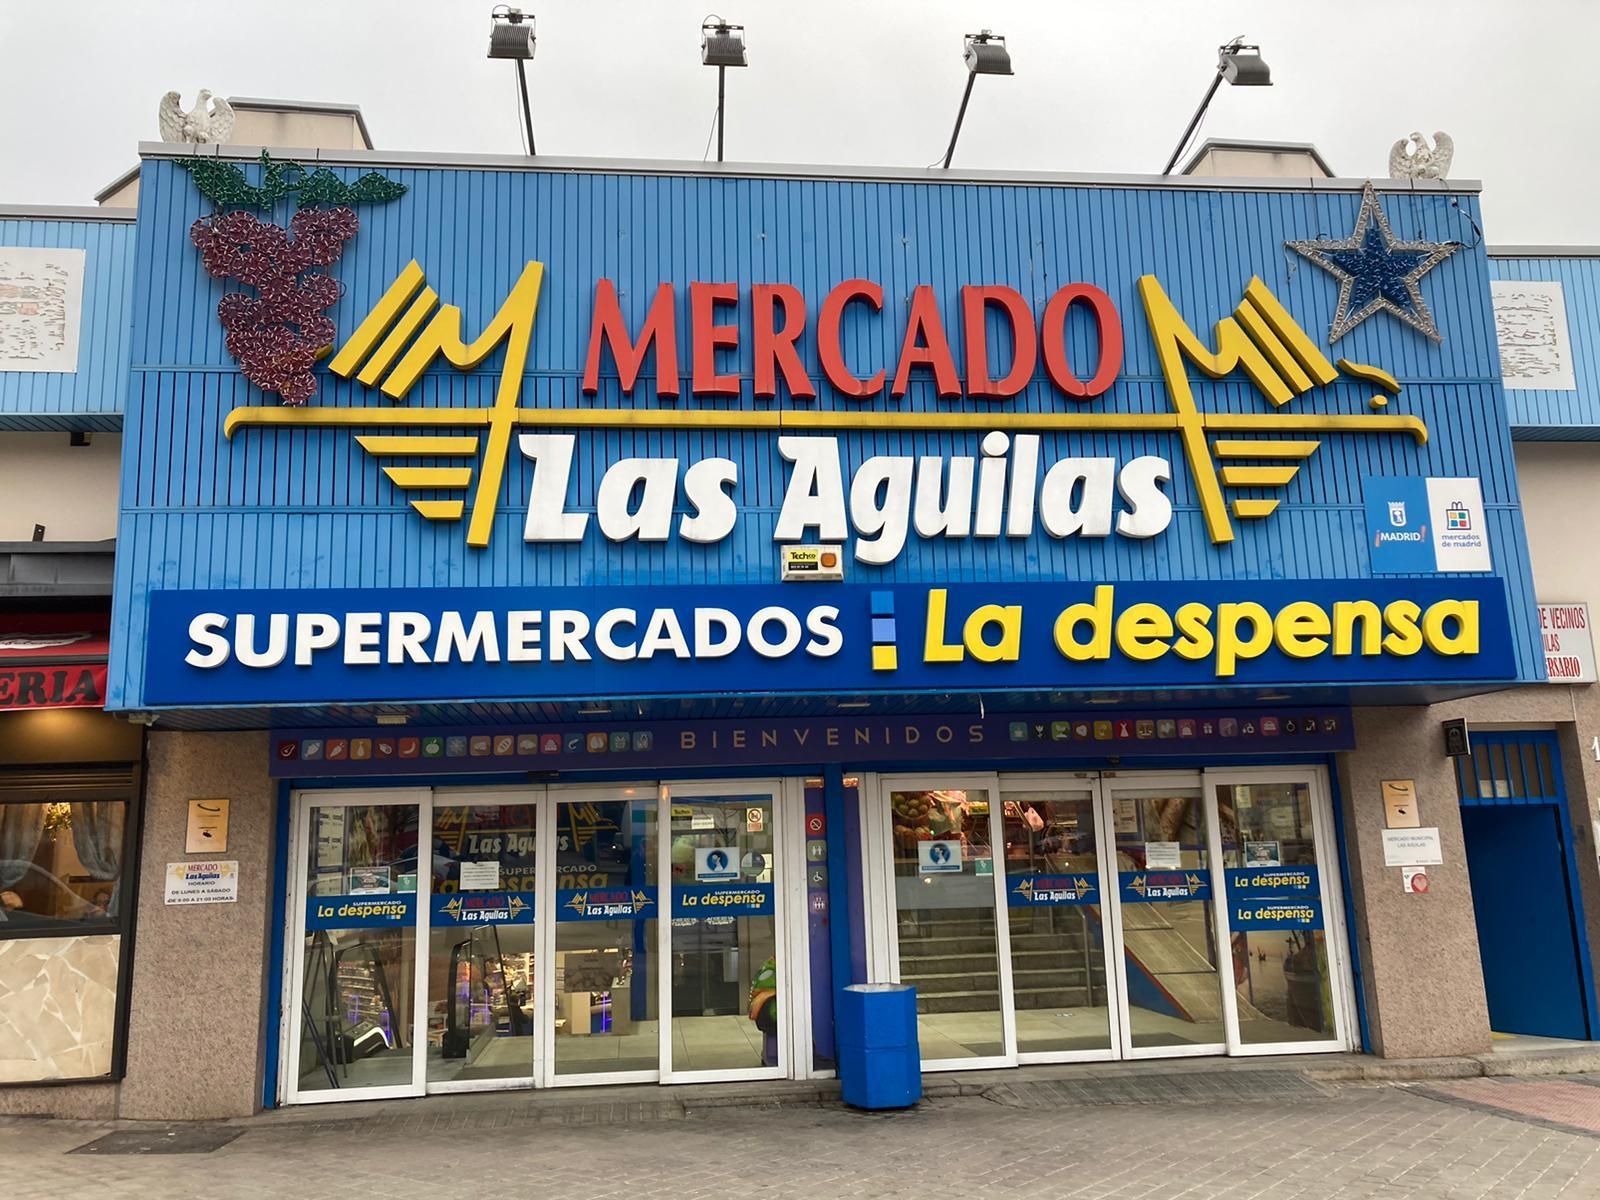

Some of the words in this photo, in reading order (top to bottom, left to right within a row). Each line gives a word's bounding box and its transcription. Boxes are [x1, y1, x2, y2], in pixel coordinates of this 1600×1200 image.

[582, 278, 1123, 399] MERCADO
[518, 434, 738, 543] Las
[773, 430, 1173, 565] Aguilas
[1453, 540, 1482, 548] madrid
[1549, 607, 1585, 630] VECINOS
[184, 605, 844, 669] SUPERMERCADOS
[923, 588, 1022, 663] La
[1054, 584, 1480, 676] despensa
[1547, 656, 1581, 678] RSARIO
[680, 725, 984, 749] BIENVENIDOS
[468, 834, 502, 854] Las
[1235, 876, 1248, 887] La
[1252, 875, 1310, 888] despensa
[682, 894, 697, 906] La
[701, 892, 765, 907] despensa
[1034, 892, 1048, 901] Las
[1049, 890, 1076, 902] Aguilas
[1147, 887, 1161, 897] Las
[1162, 886, 1188, 898] Aguilas
[317, 905, 334, 917] La
[338, 904, 407, 918] despensa
[462, 911, 478, 921] Las
[479, 910, 508, 922] Aguilas
[587, 905, 602, 915] Las
[603, 904, 632, 916] Aguilas
[1238, 908, 1252, 920] La
[1255, 908, 1314, 921] despensa
